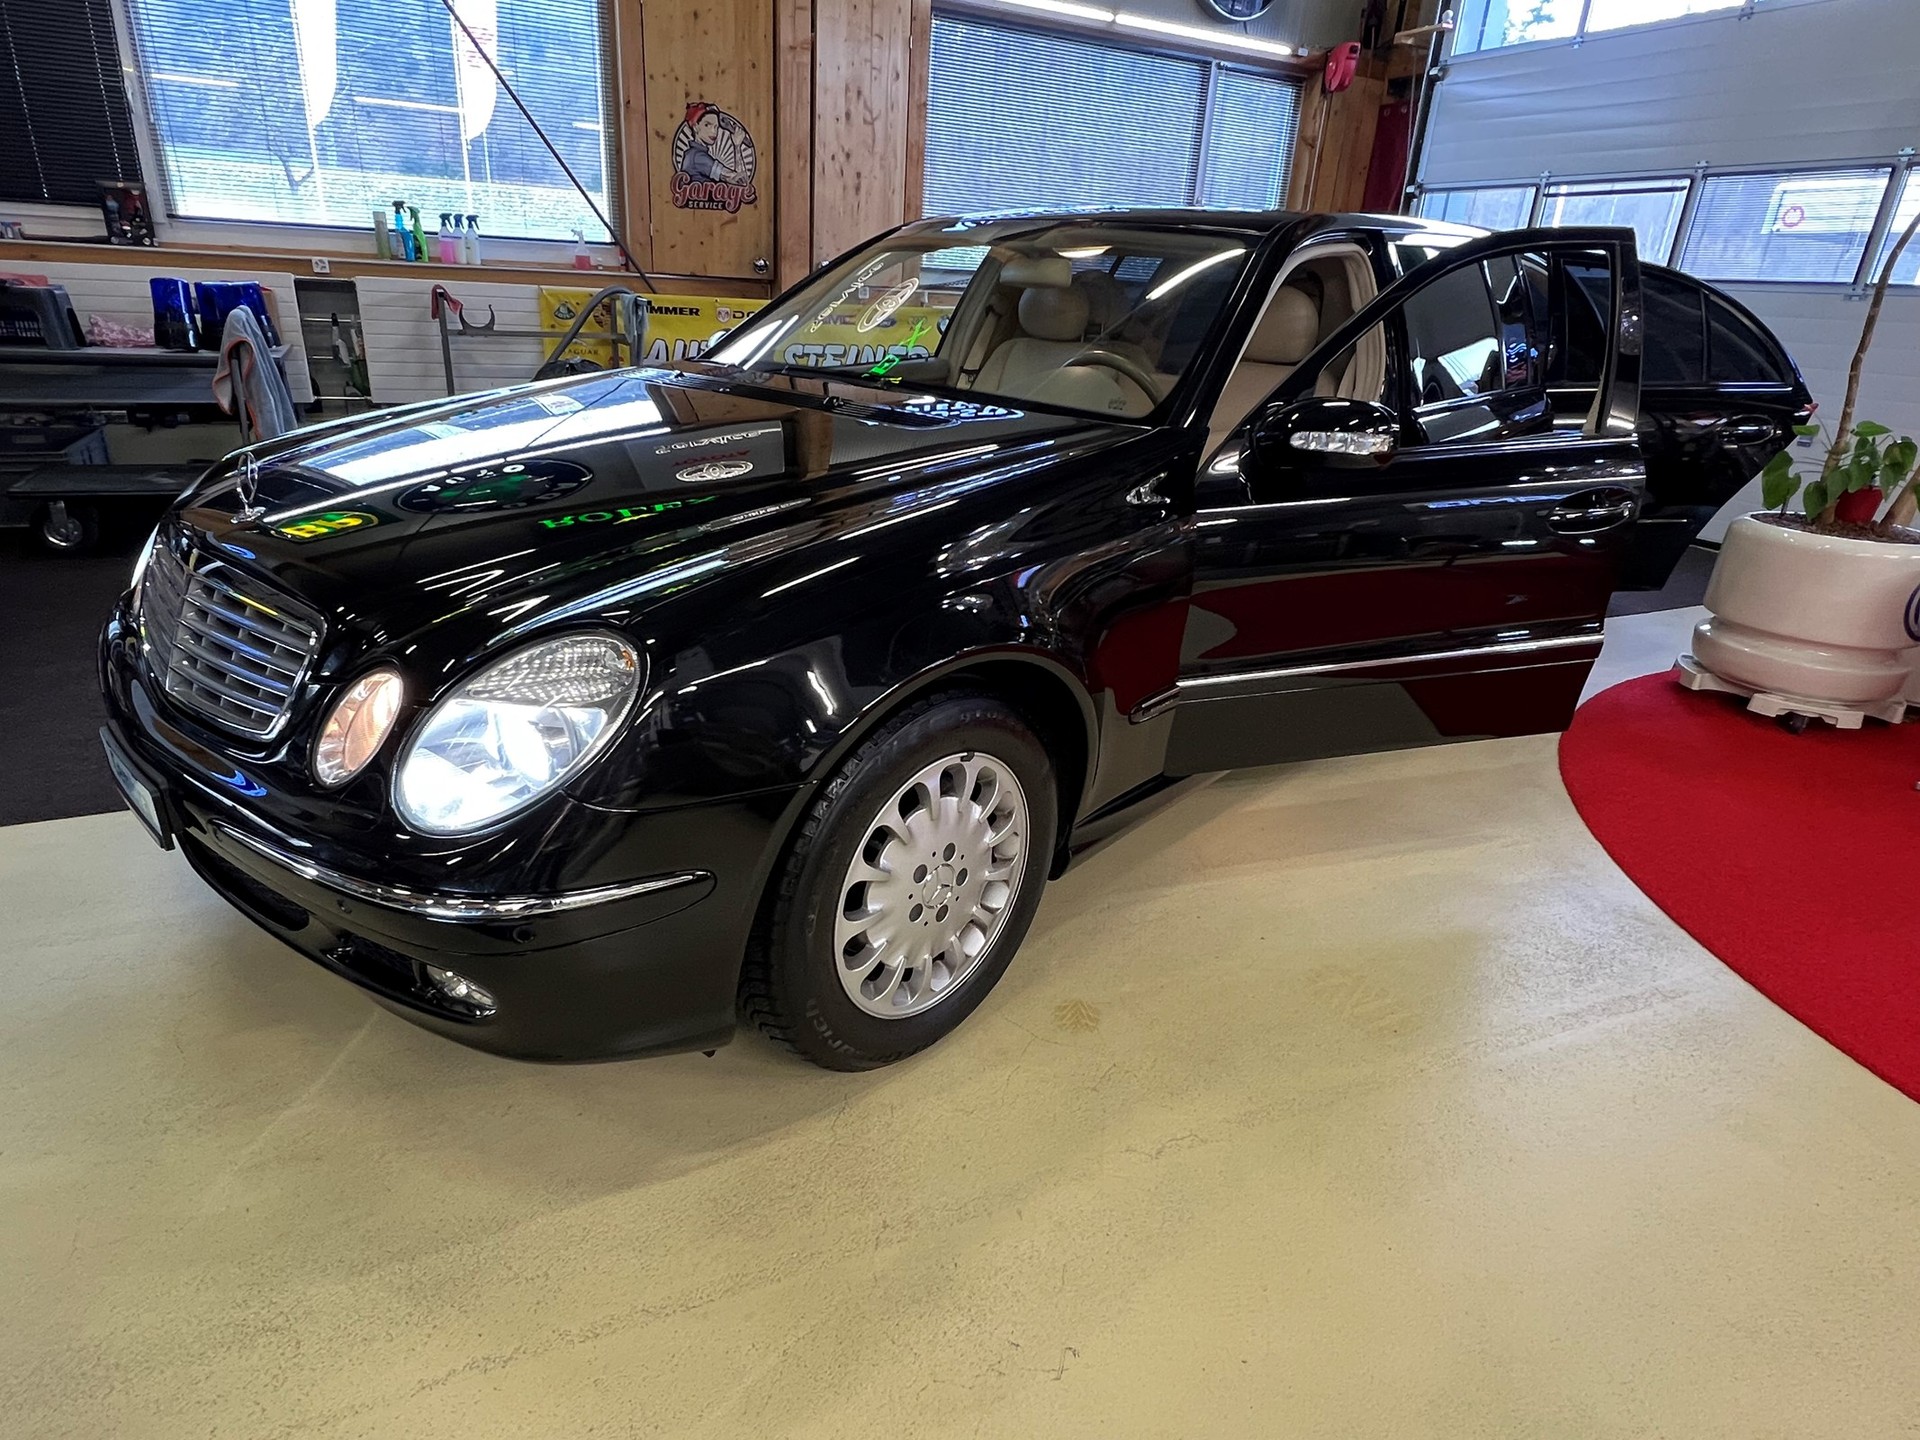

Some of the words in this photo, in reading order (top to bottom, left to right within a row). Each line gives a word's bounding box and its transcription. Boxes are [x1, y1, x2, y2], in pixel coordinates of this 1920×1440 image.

[671, 172, 756, 211] Garage
[688, 201, 723, 209] SERVICE
[647, 305, 700, 316] MMER
[567, 348, 599, 356] AGUAR
